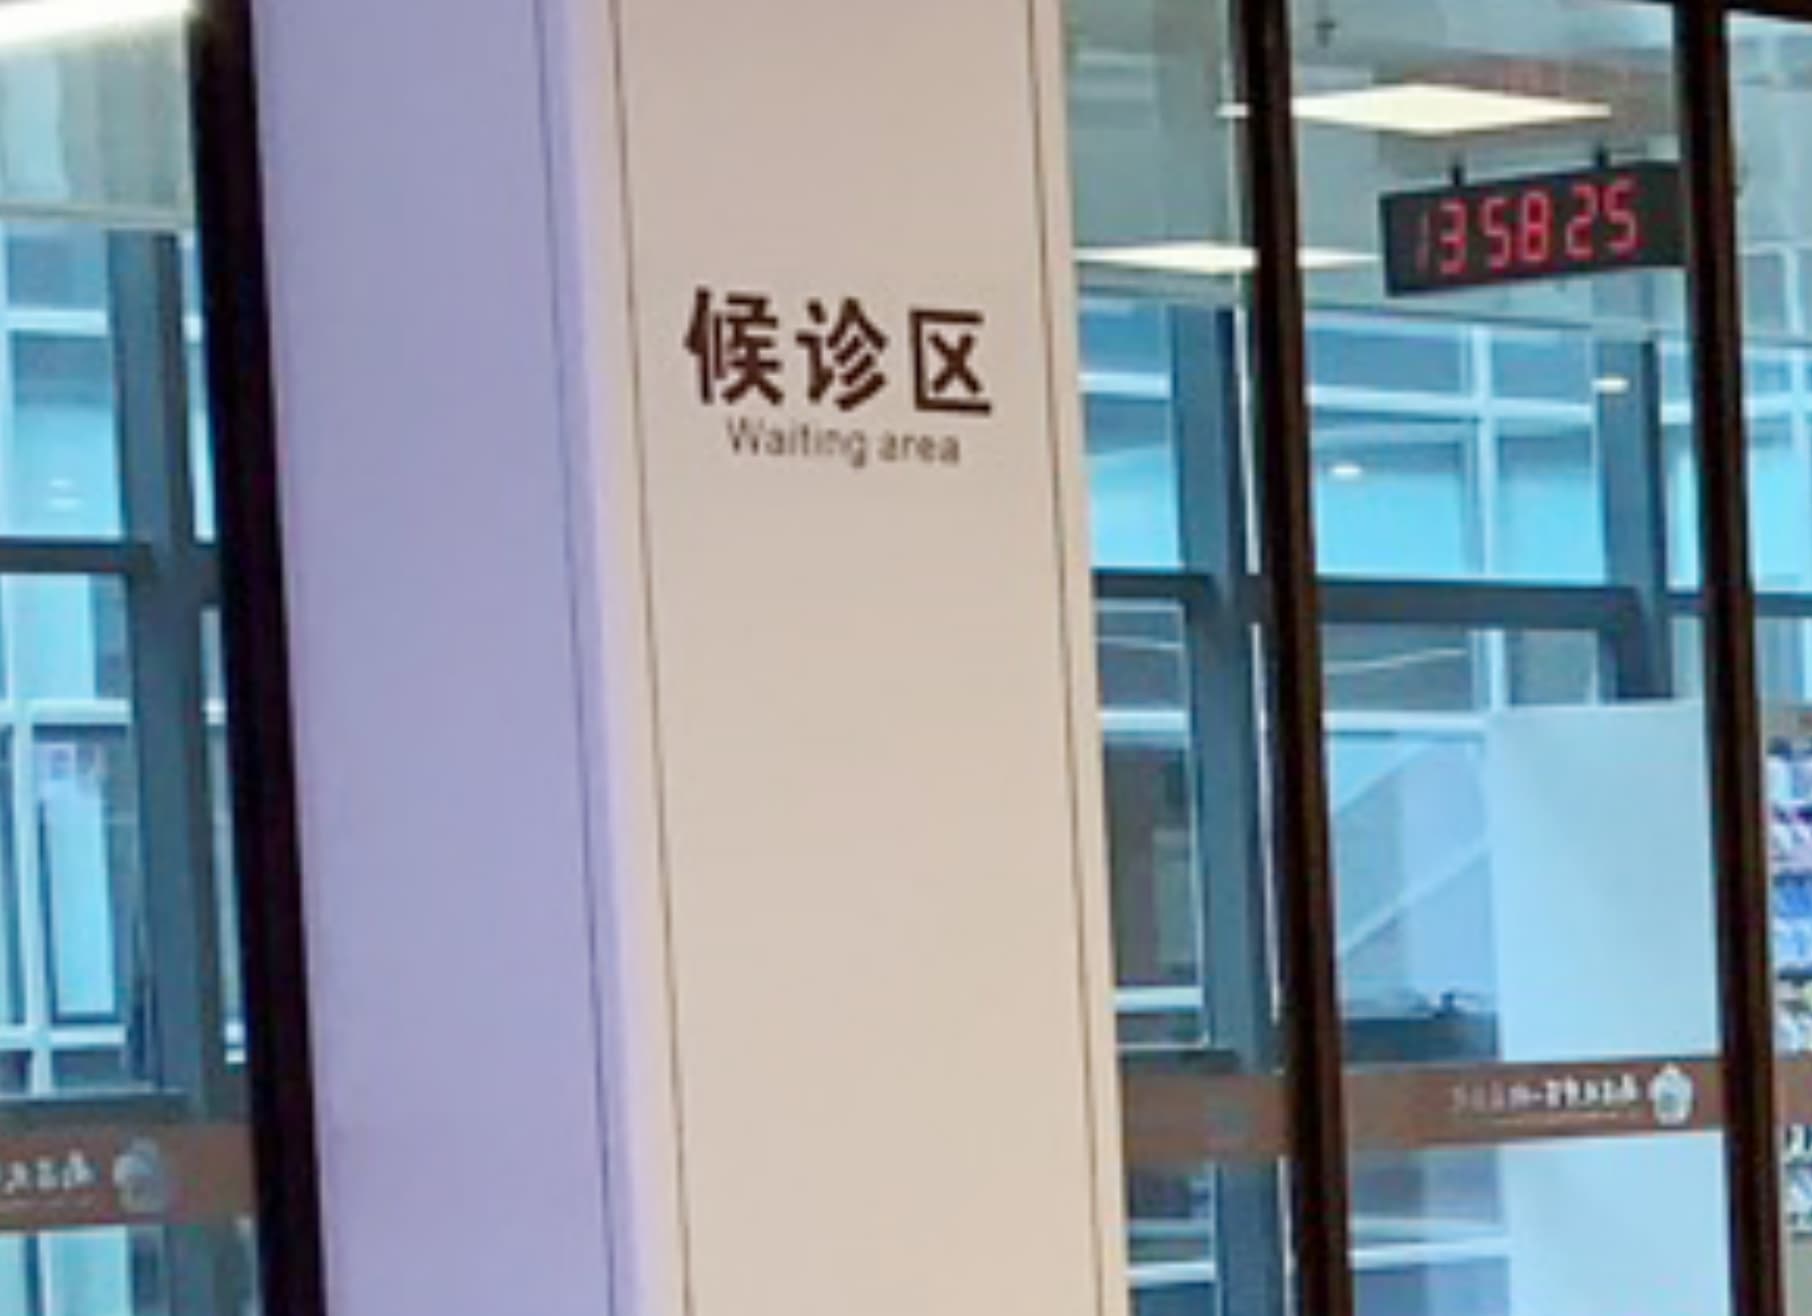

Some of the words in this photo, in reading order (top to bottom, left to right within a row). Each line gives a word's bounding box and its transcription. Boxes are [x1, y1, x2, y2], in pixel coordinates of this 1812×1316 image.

[684, 286, 992, 415] 候诊区
[726, 416, 868, 469] Waiting
[877, 431, 960, 464] area
